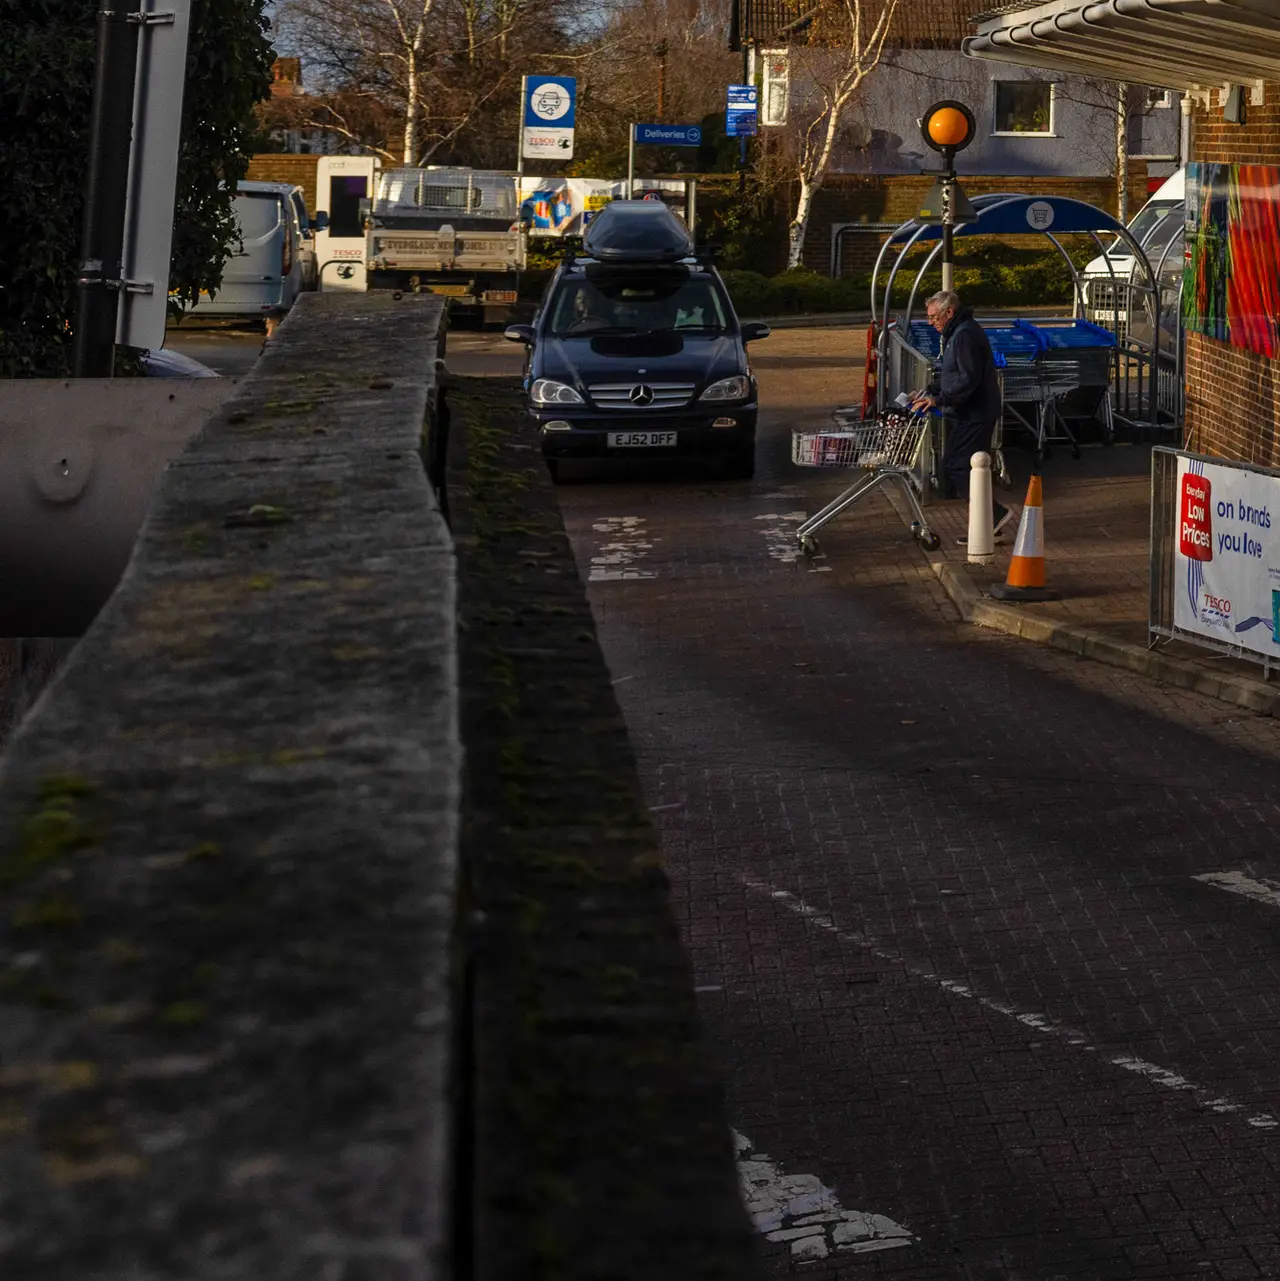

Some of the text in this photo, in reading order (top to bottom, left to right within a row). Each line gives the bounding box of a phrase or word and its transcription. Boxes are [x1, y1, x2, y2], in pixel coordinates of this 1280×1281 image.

[528, 137, 555, 145] TESCO
[645, 129, 686, 139] Deliveries
[616, 433, 674, 446] EJ52 DFF
[1187, 499, 1205, 522] Low
[1217, 500, 1234, 519] on
[1182, 522, 1211, 548] Prices
[1217, 532, 1242, 554] you
[1204, 594, 1231, 613] TESCO
